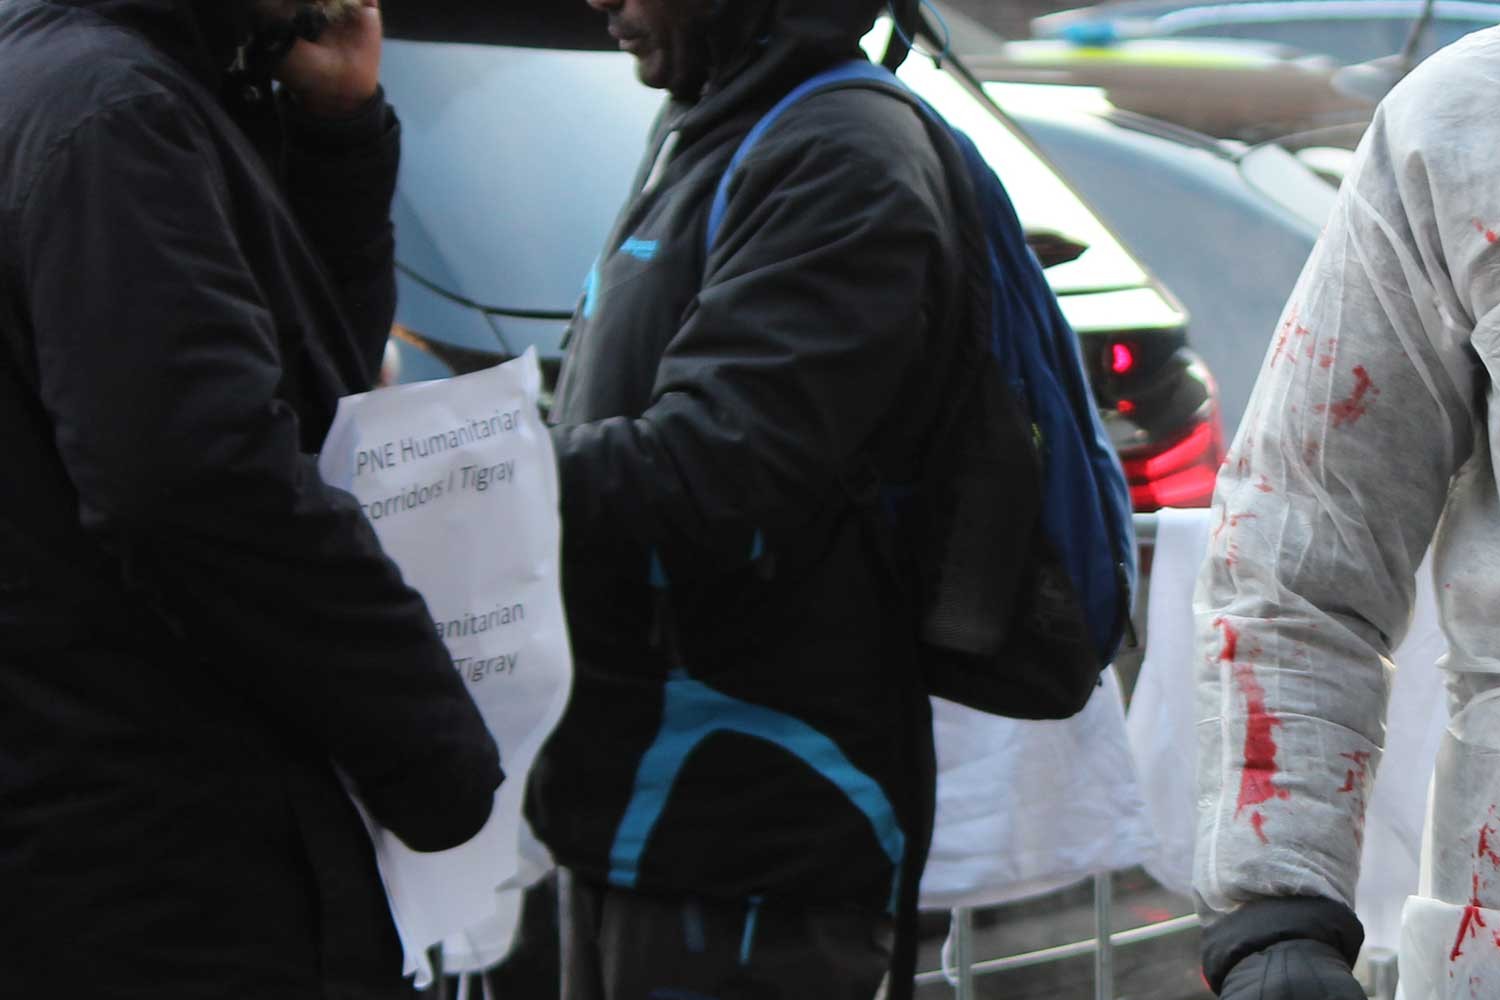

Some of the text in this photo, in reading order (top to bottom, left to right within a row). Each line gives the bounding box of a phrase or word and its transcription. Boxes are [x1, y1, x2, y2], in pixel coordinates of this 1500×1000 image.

[354, 442, 396, 476] PNE
[460, 458, 516, 491] Tigray
[434, 603, 525, 639] anitarian
[452, 651, 519, 682] Tigray
